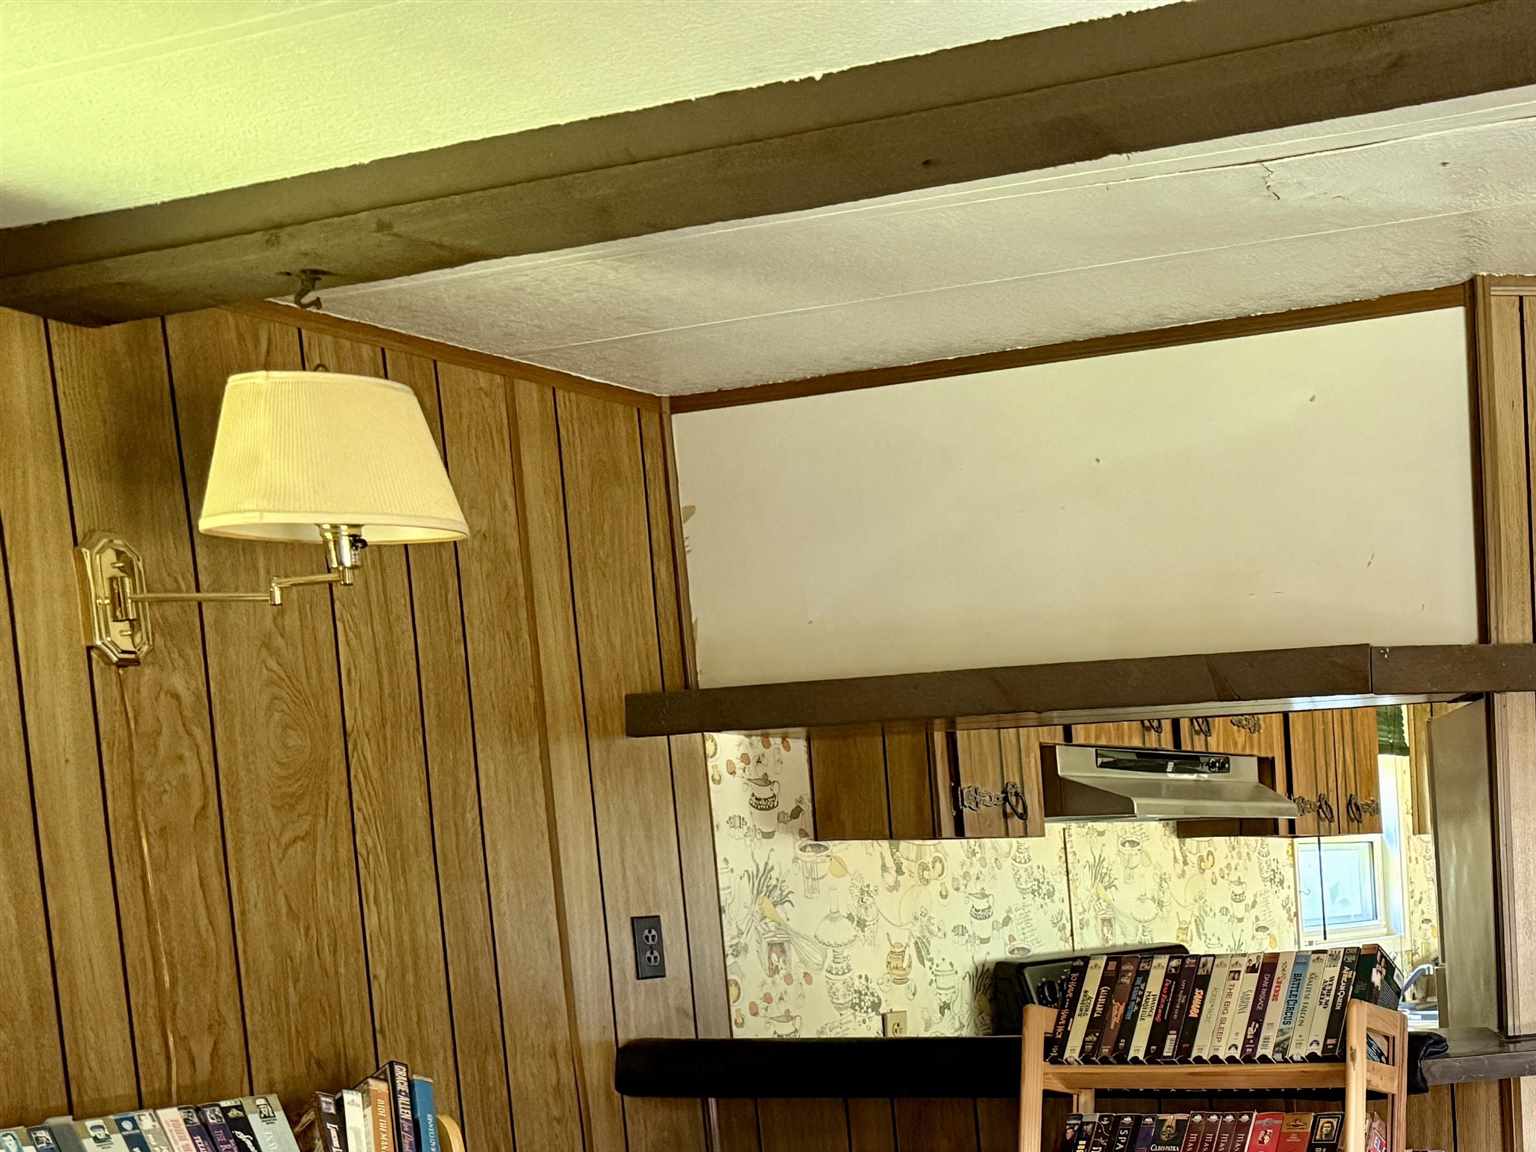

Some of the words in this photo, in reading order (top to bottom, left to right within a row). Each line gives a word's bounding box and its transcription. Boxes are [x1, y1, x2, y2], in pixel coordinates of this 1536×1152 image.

[1225, 982, 1235, 998] THE
[1288, 972, 1303, 999] BATTLE
[1188, 987, 1204, 1018] SAHARA
[1221, 1000, 1230, 1015] BIG
[1281, 998, 1297, 1026] CIRCUS
[1214, 1016, 1226, 1042] SLEEP
[398, 1093, 411, 1122] ALLEN
